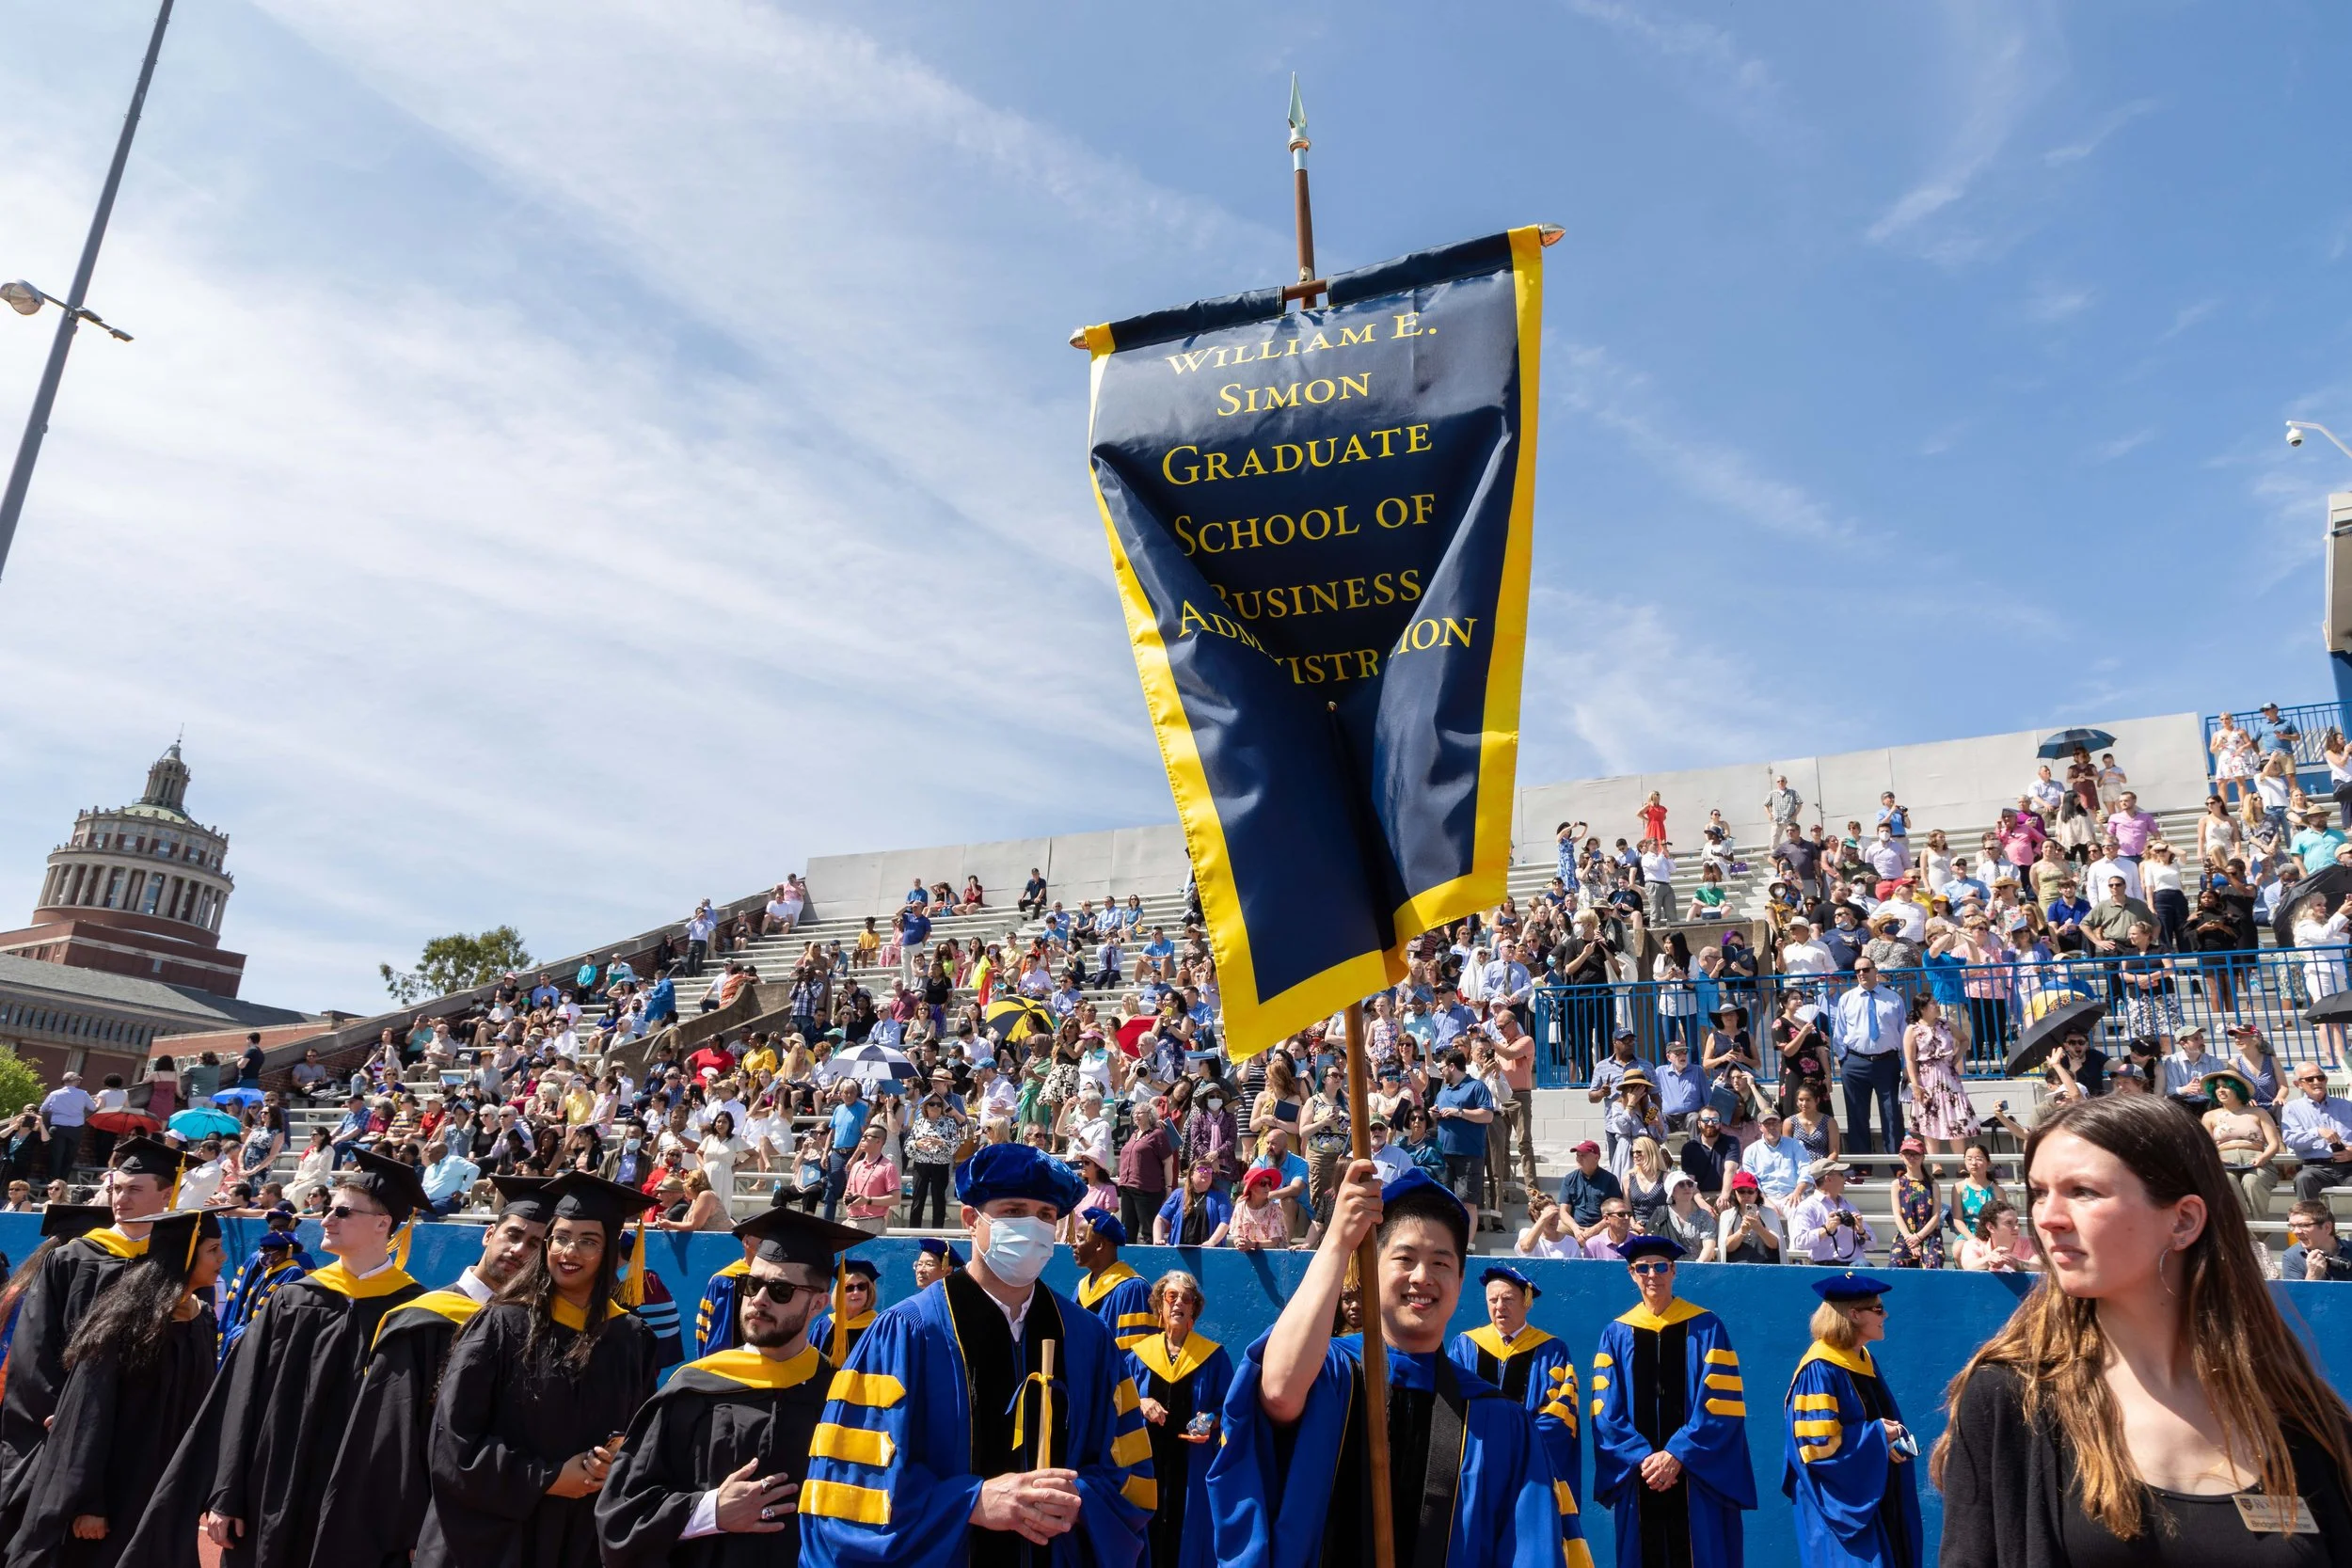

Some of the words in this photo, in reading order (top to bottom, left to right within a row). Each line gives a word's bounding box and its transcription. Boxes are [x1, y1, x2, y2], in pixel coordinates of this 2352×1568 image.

[1165, 323, 1377, 375] WILLIAM
[1391, 311, 1438, 341] E.
[1216, 372, 1372, 417] SIMON
[1162, 423, 1434, 486] GRADUATE
[1174, 504, 1360, 557] SCHOOL
[1375, 493, 1436, 529] OF
